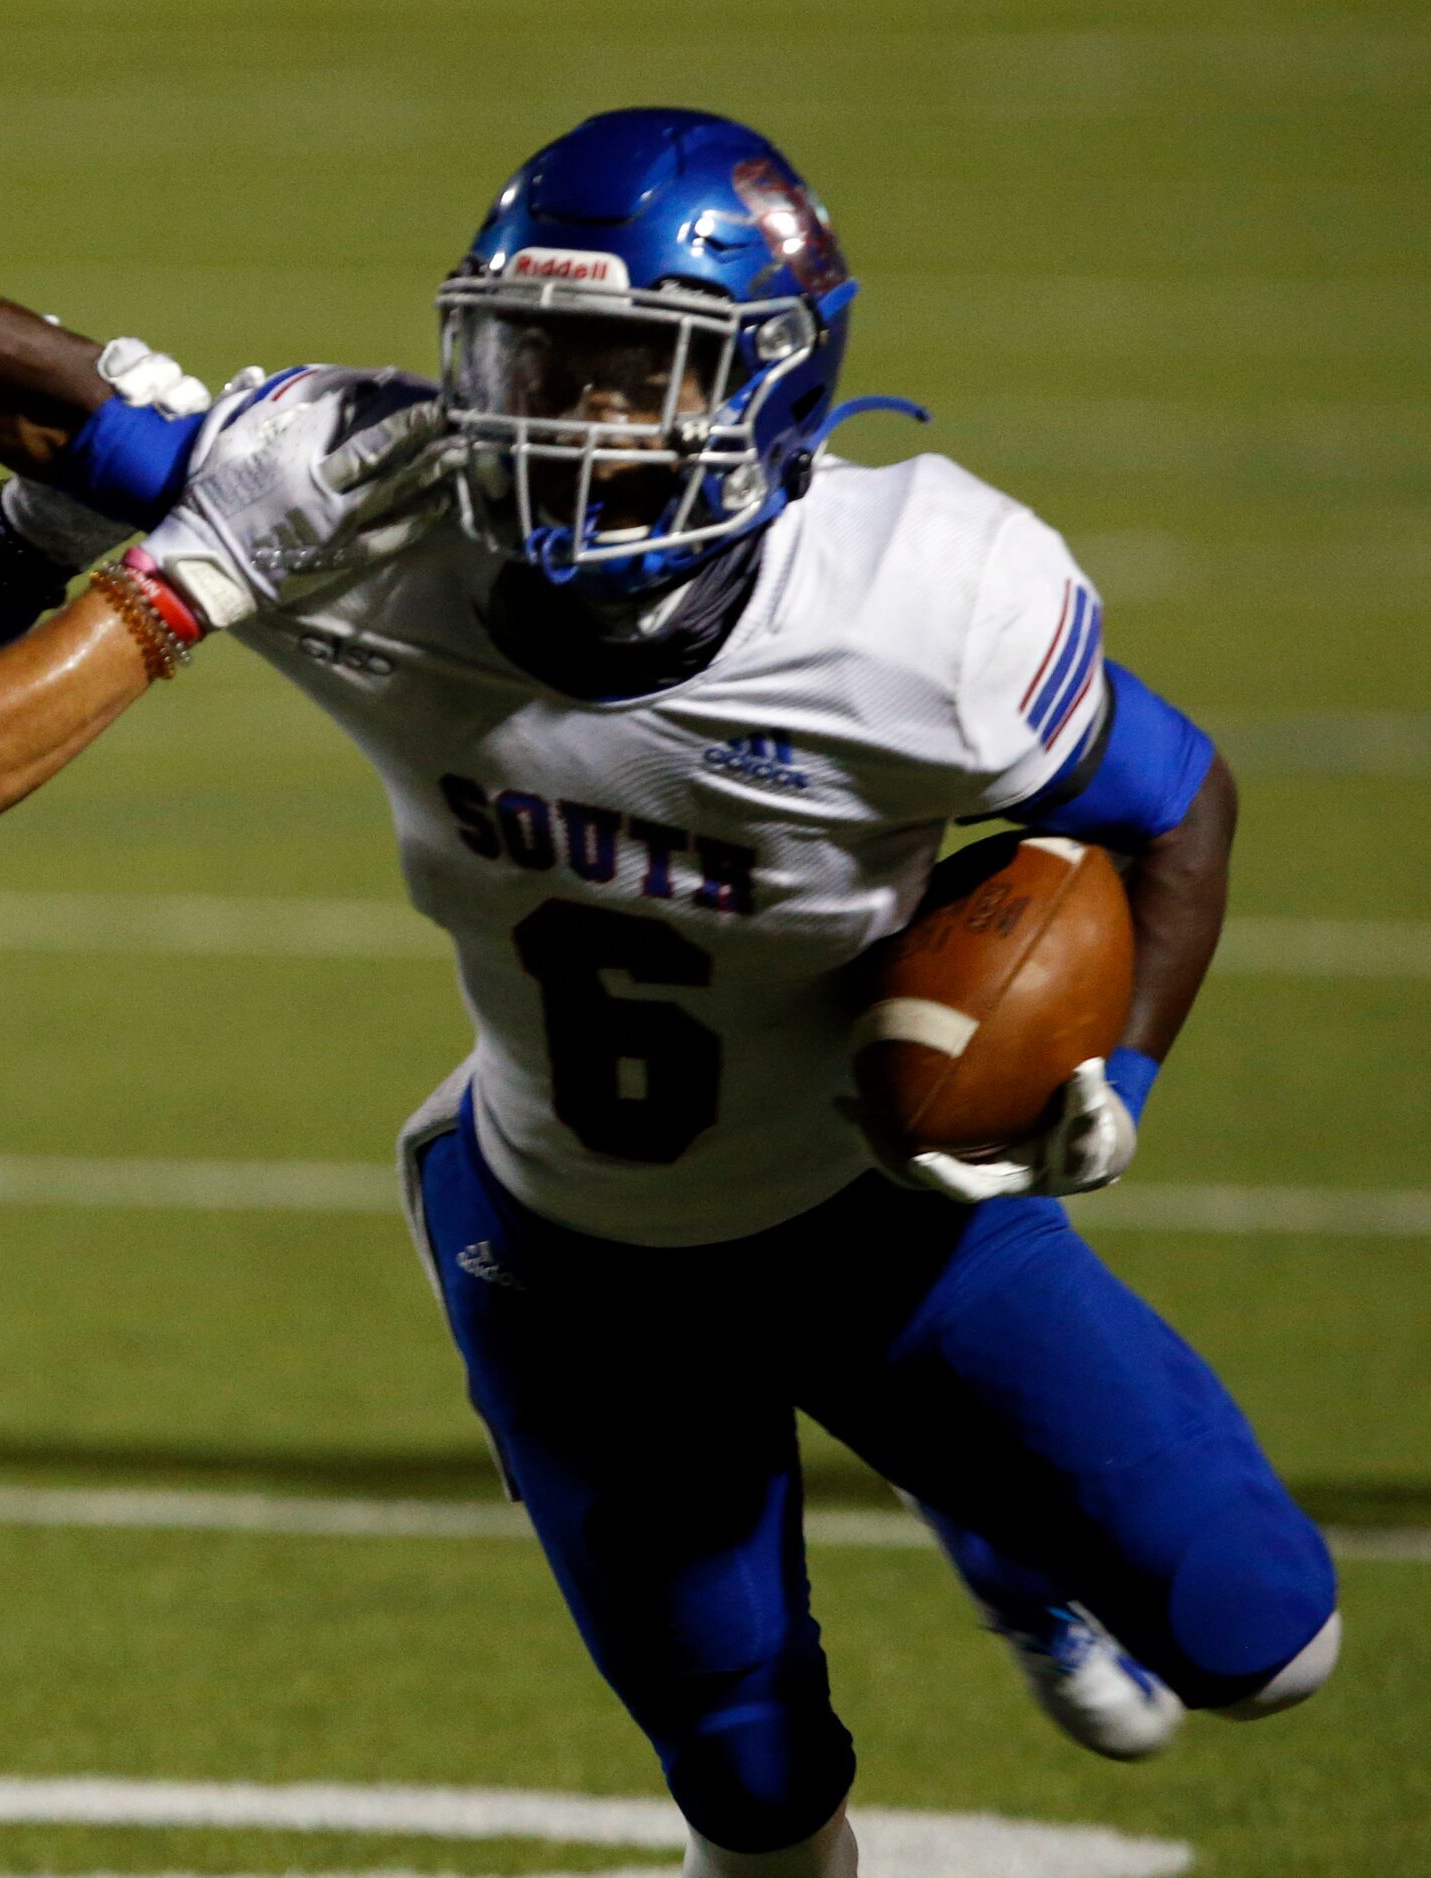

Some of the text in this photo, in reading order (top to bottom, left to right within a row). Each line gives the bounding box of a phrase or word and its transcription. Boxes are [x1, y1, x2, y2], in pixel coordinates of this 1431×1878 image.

[515, 255, 609, 281] Riddell
[703, 747, 810, 789] adidas
[438, 773, 758, 916] SOUTH
[513, 897, 724, 1164] 6
